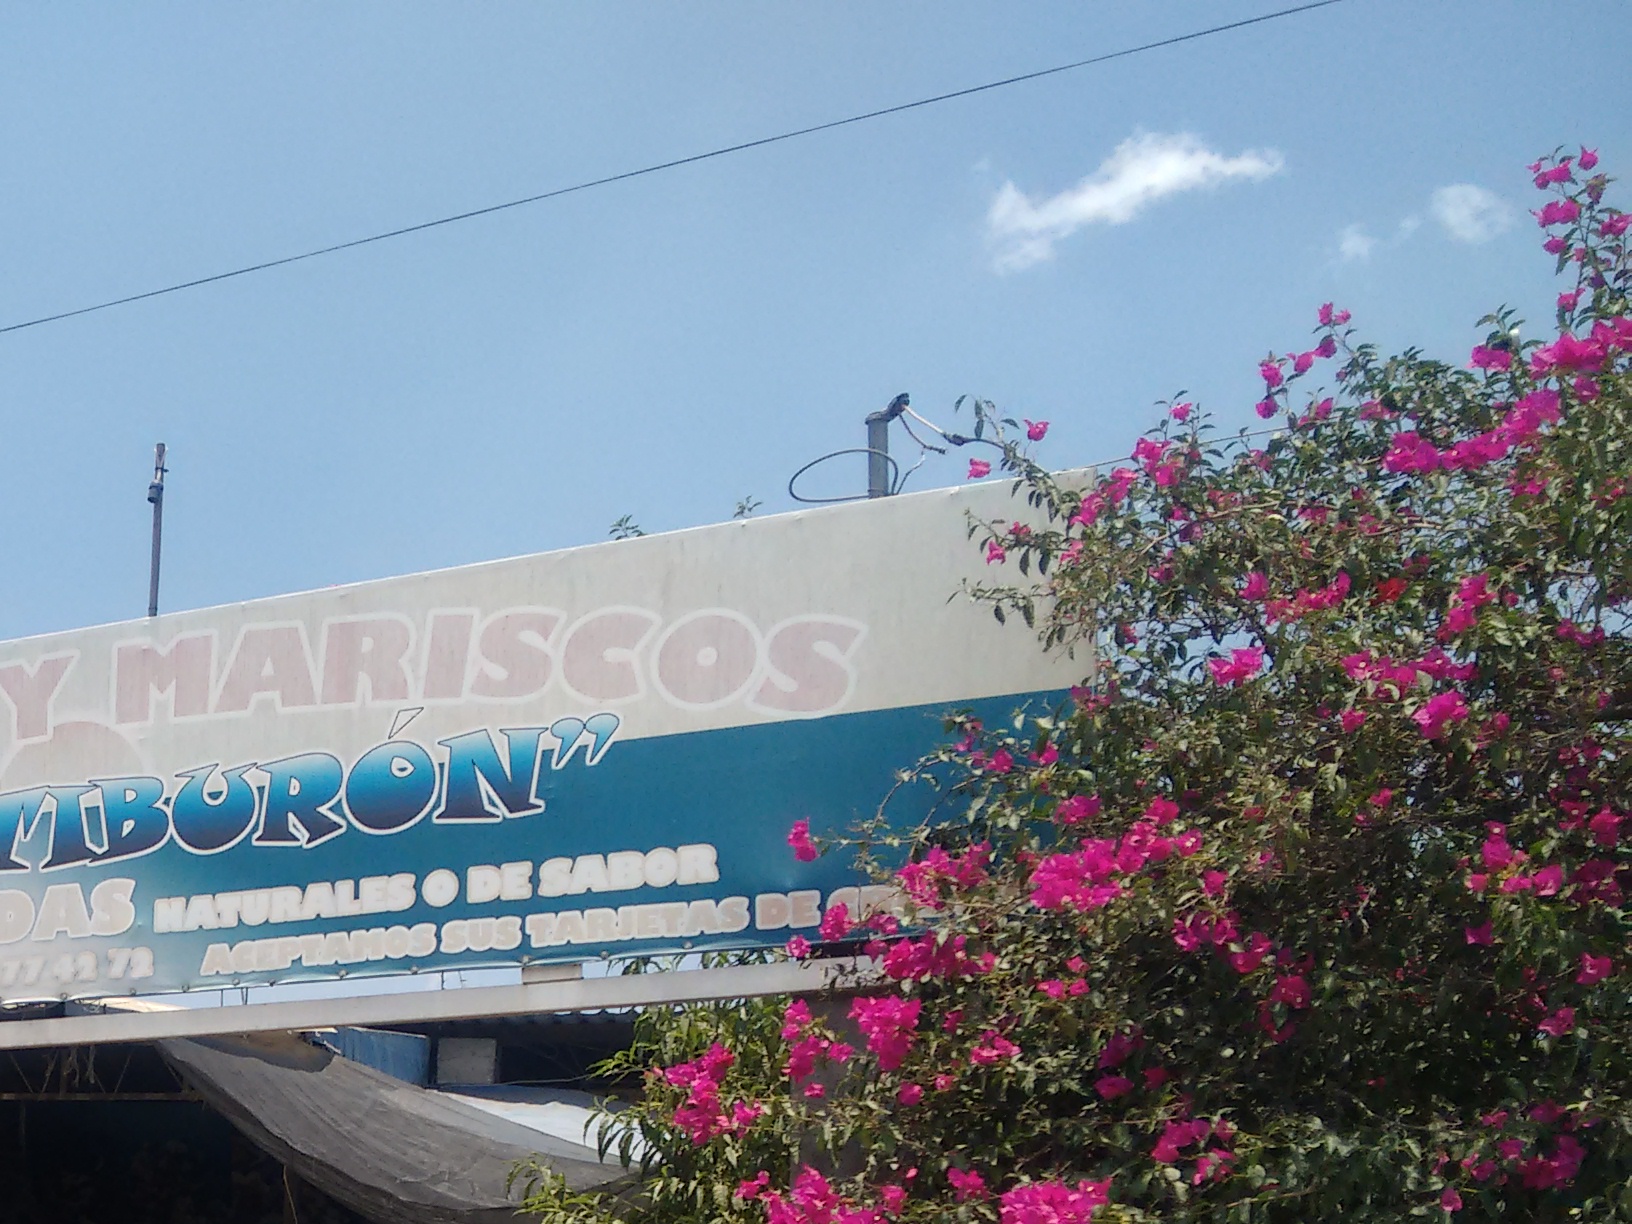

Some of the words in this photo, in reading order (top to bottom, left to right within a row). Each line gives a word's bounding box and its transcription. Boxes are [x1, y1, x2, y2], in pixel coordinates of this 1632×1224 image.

[112, 606, 868, 726] MARISCOS
[153, 872, 417, 933] NATURALES
[421, 868, 459, 907] O
[467, 860, 533, 904] DE
[537, 843, 719, 898] SABOR
[107, 947, 154, 979] 72
[200, 922, 438, 976] ACEPTAMOS
[440, 916, 523, 952] SUS
[525, 896, 750, 949] TARJETAS
[755, 889, 822, 931] DE
